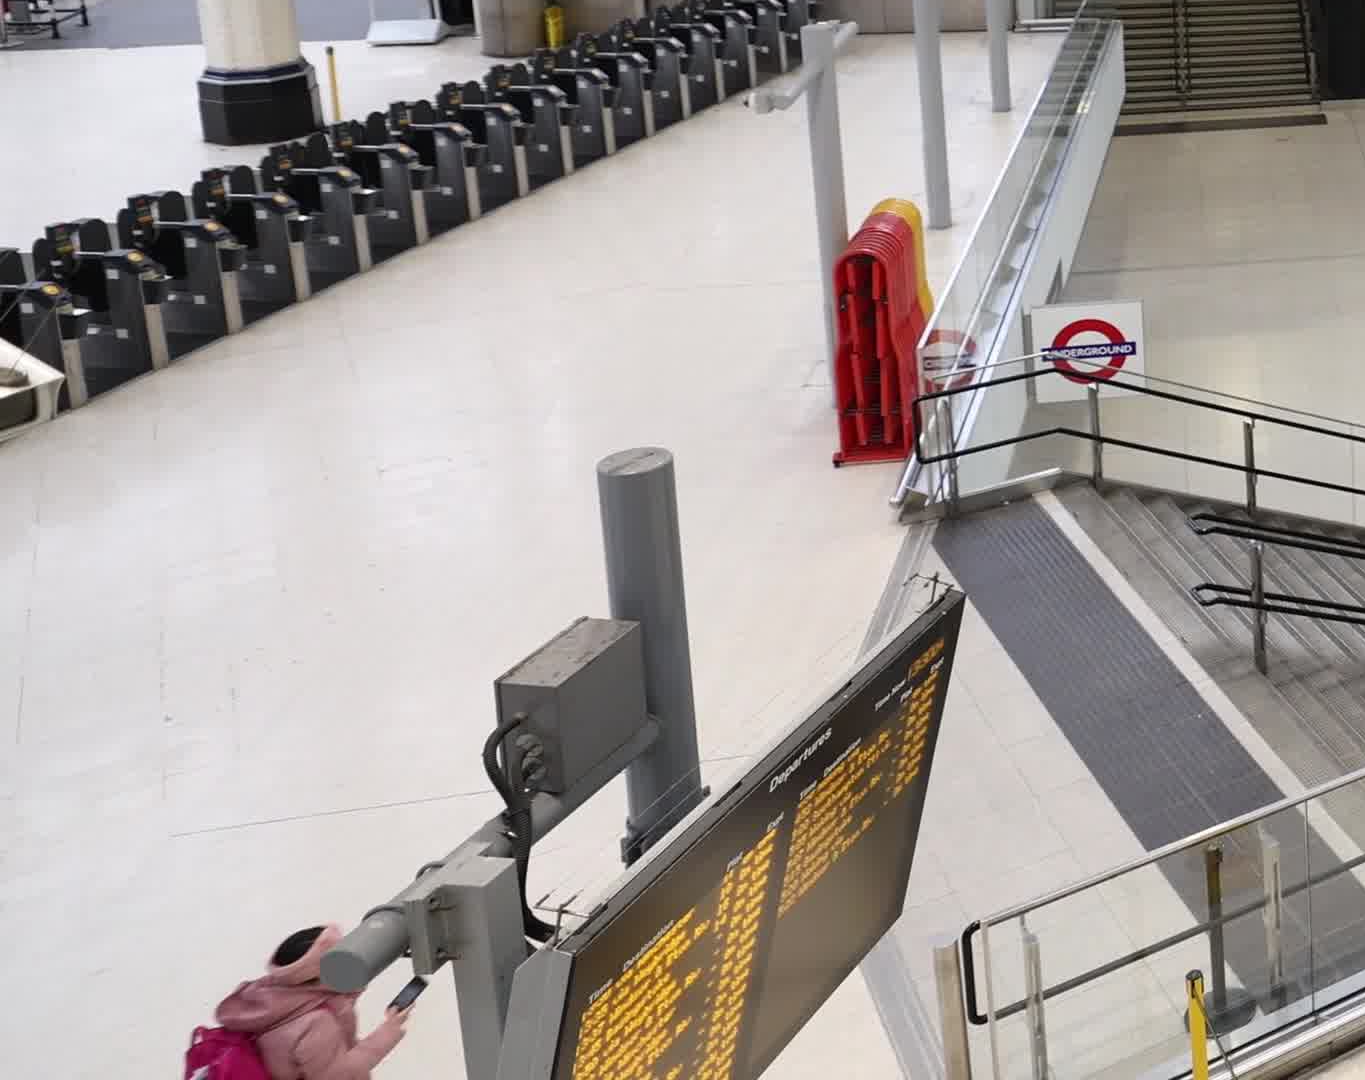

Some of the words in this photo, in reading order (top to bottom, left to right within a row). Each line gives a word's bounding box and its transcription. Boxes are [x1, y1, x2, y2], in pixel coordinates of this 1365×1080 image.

[769, 727, 833, 793] Departures
[623, 919, 675, 972] Destination
[588, 978, 613, 1004] Time
